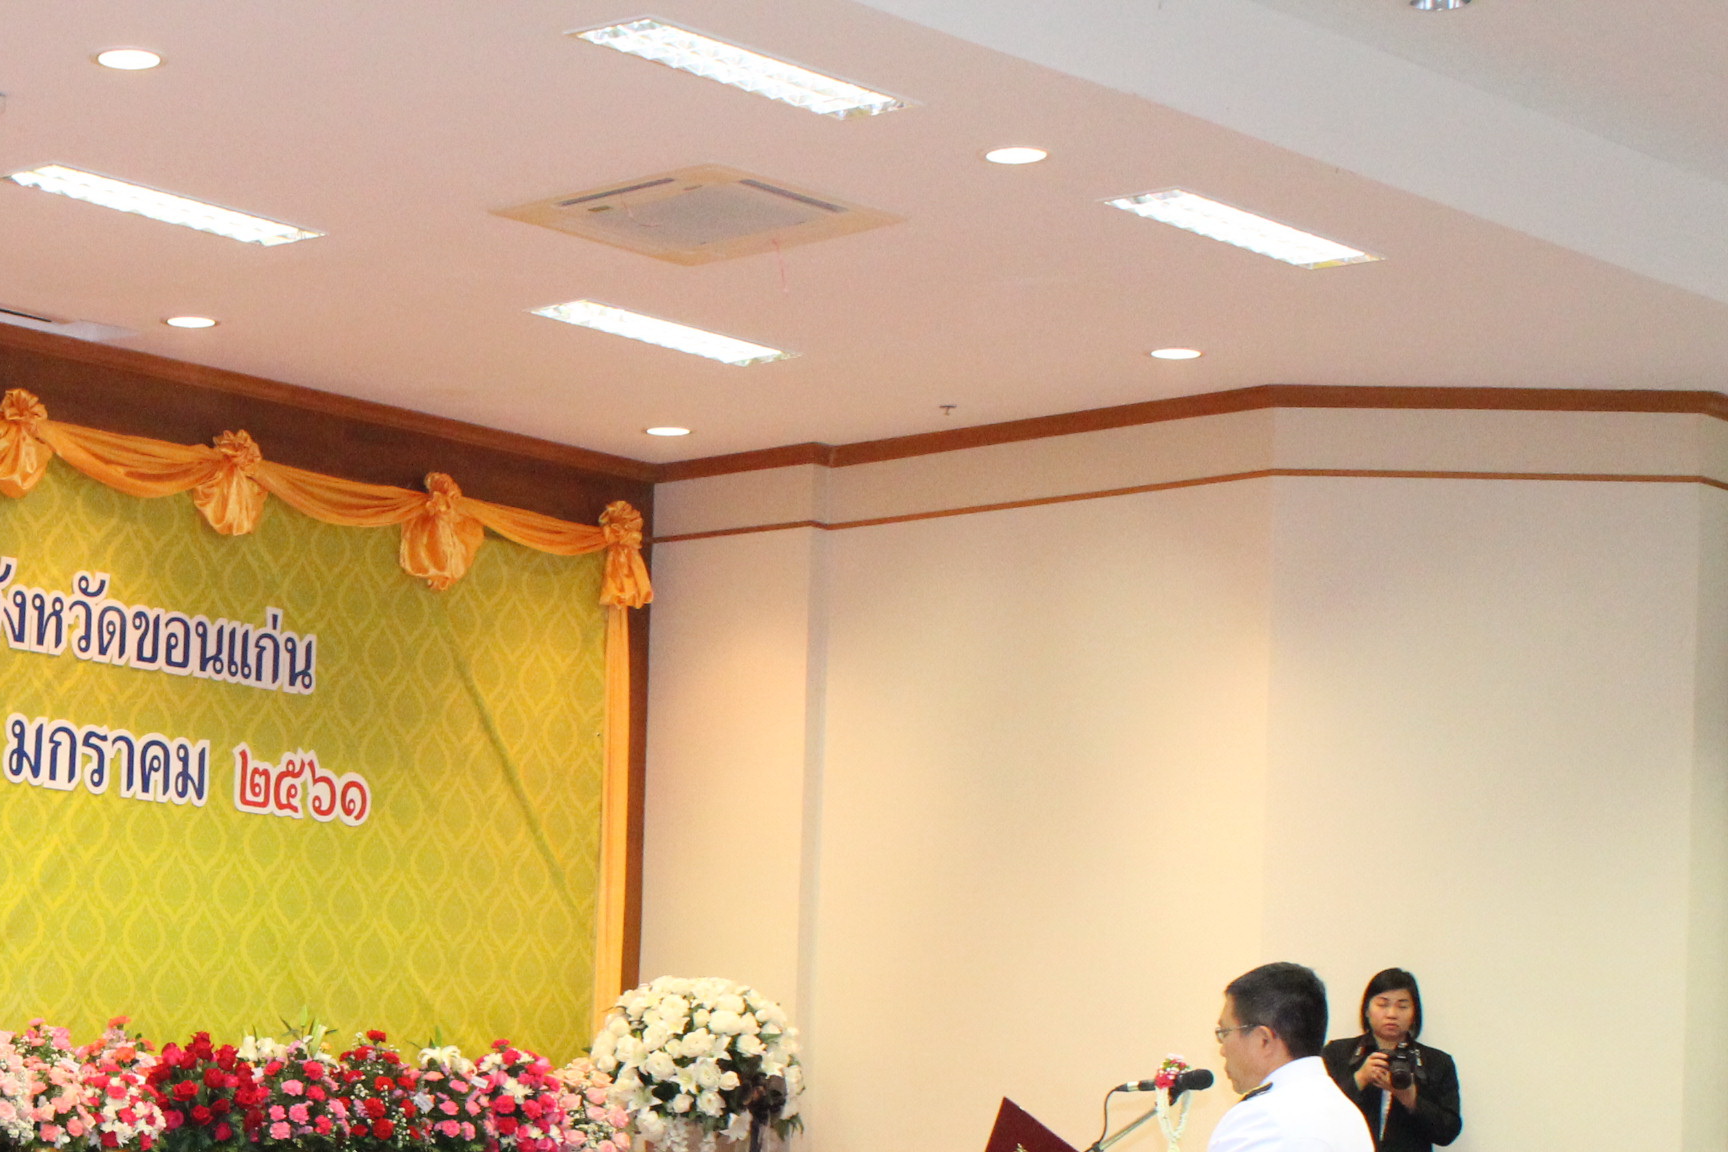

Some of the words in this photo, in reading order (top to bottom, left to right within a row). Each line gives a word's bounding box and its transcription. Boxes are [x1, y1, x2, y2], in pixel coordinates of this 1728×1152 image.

[9, 717, 207, 801] มกราคม
[238, 748, 368, 822] ๒๕๖๑
